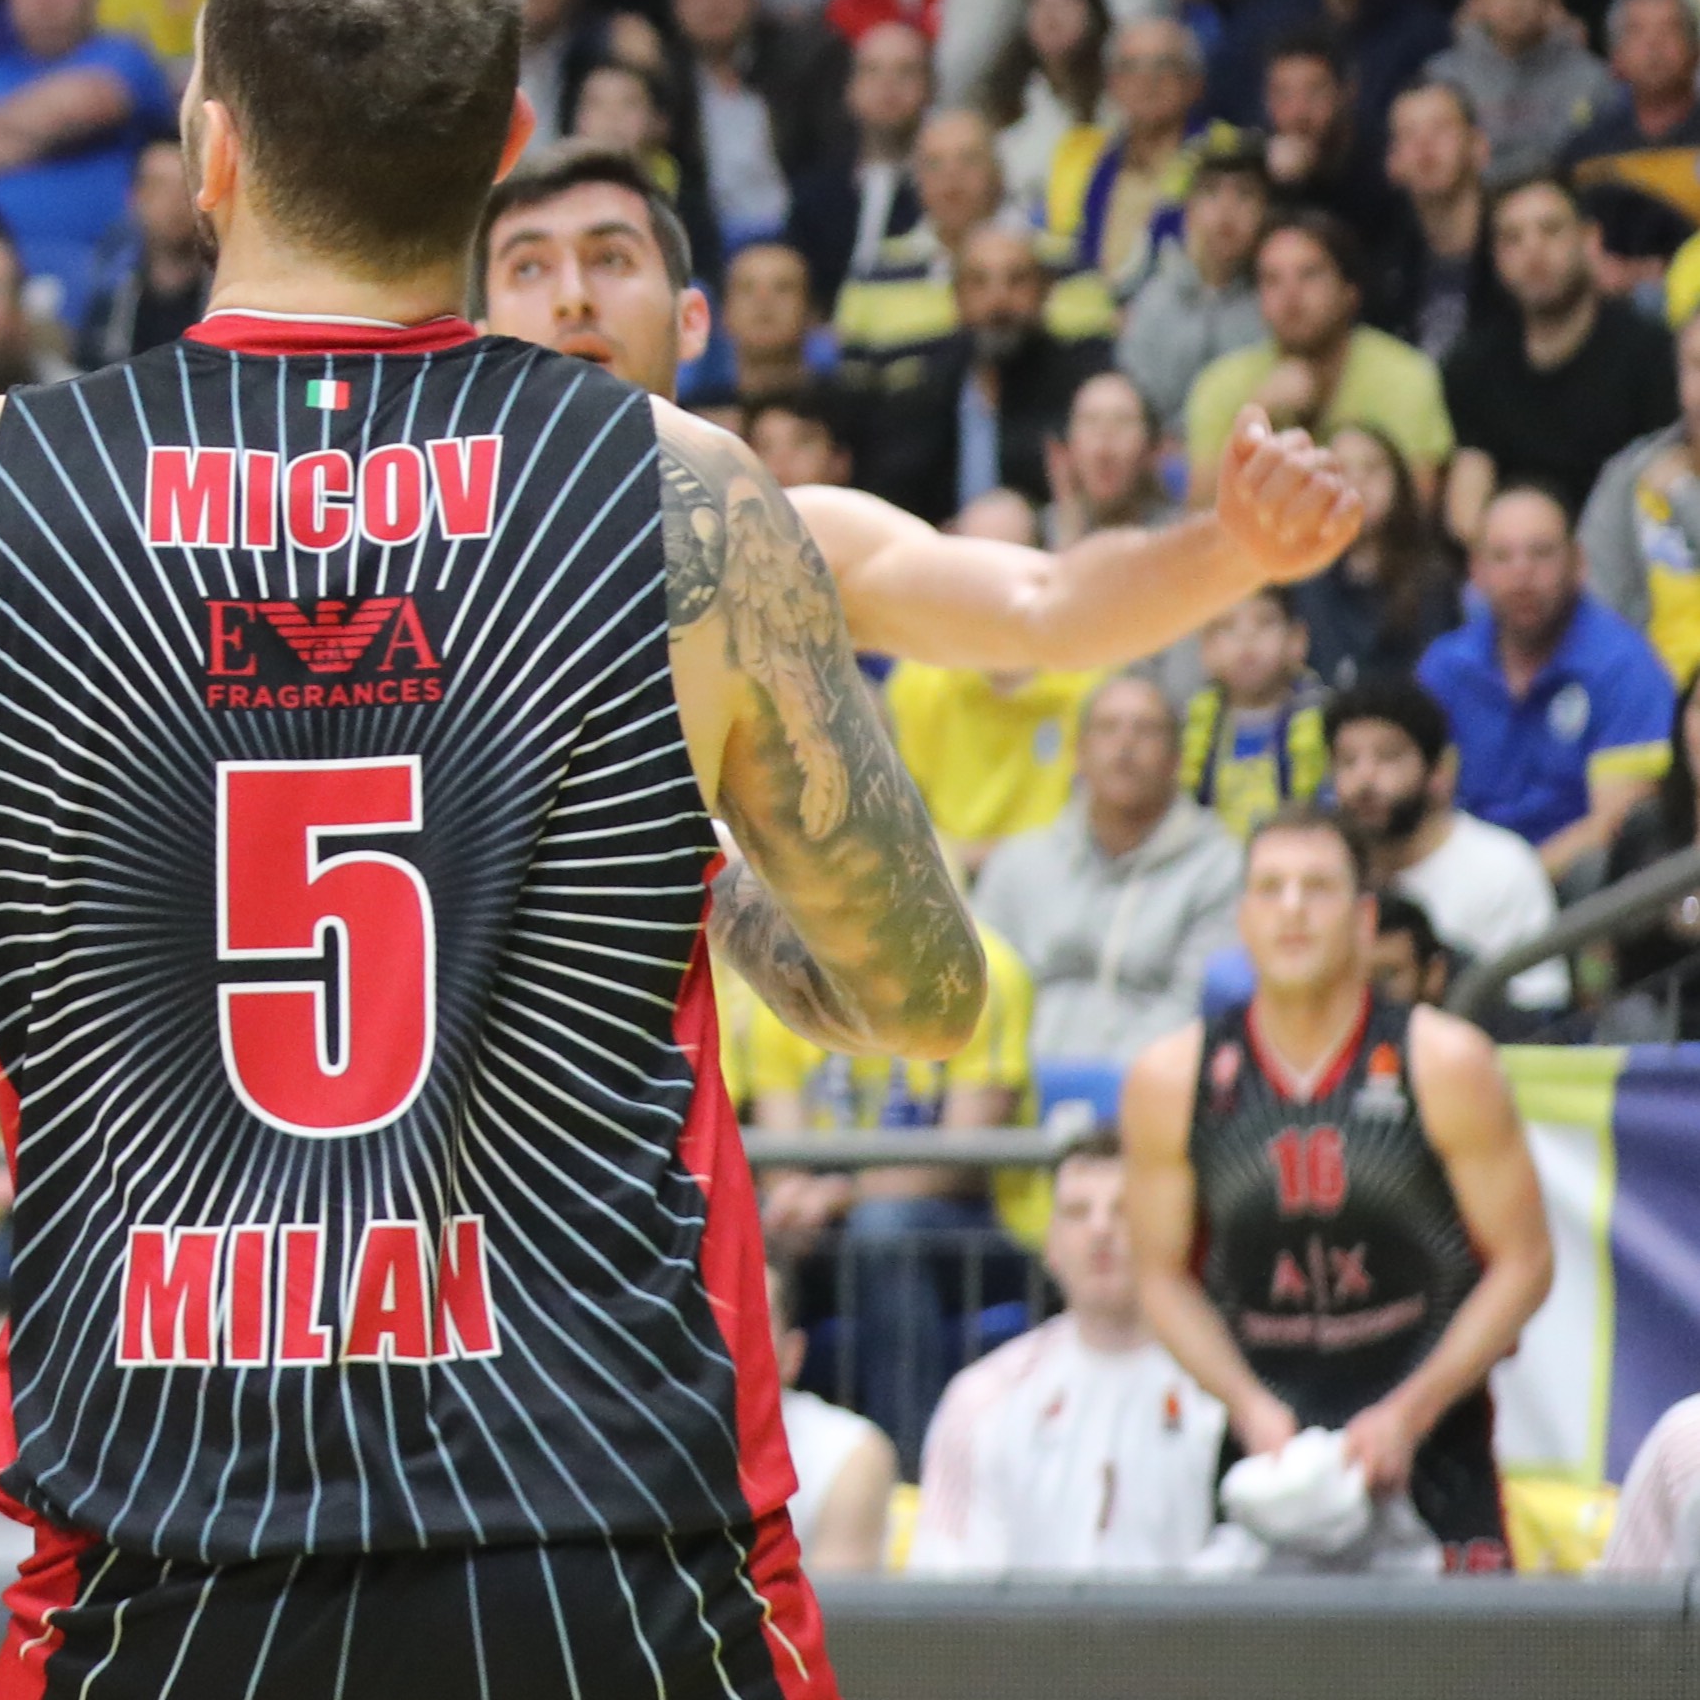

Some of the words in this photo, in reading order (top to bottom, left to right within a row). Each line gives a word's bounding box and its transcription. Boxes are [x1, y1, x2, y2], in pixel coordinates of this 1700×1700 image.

[144, 434, 503, 552] MICOV
[206, 676, 443, 710] FRAGRANCES
[215, 754, 437, 1140] 5
[115, 1214, 502, 1369] MILAN
